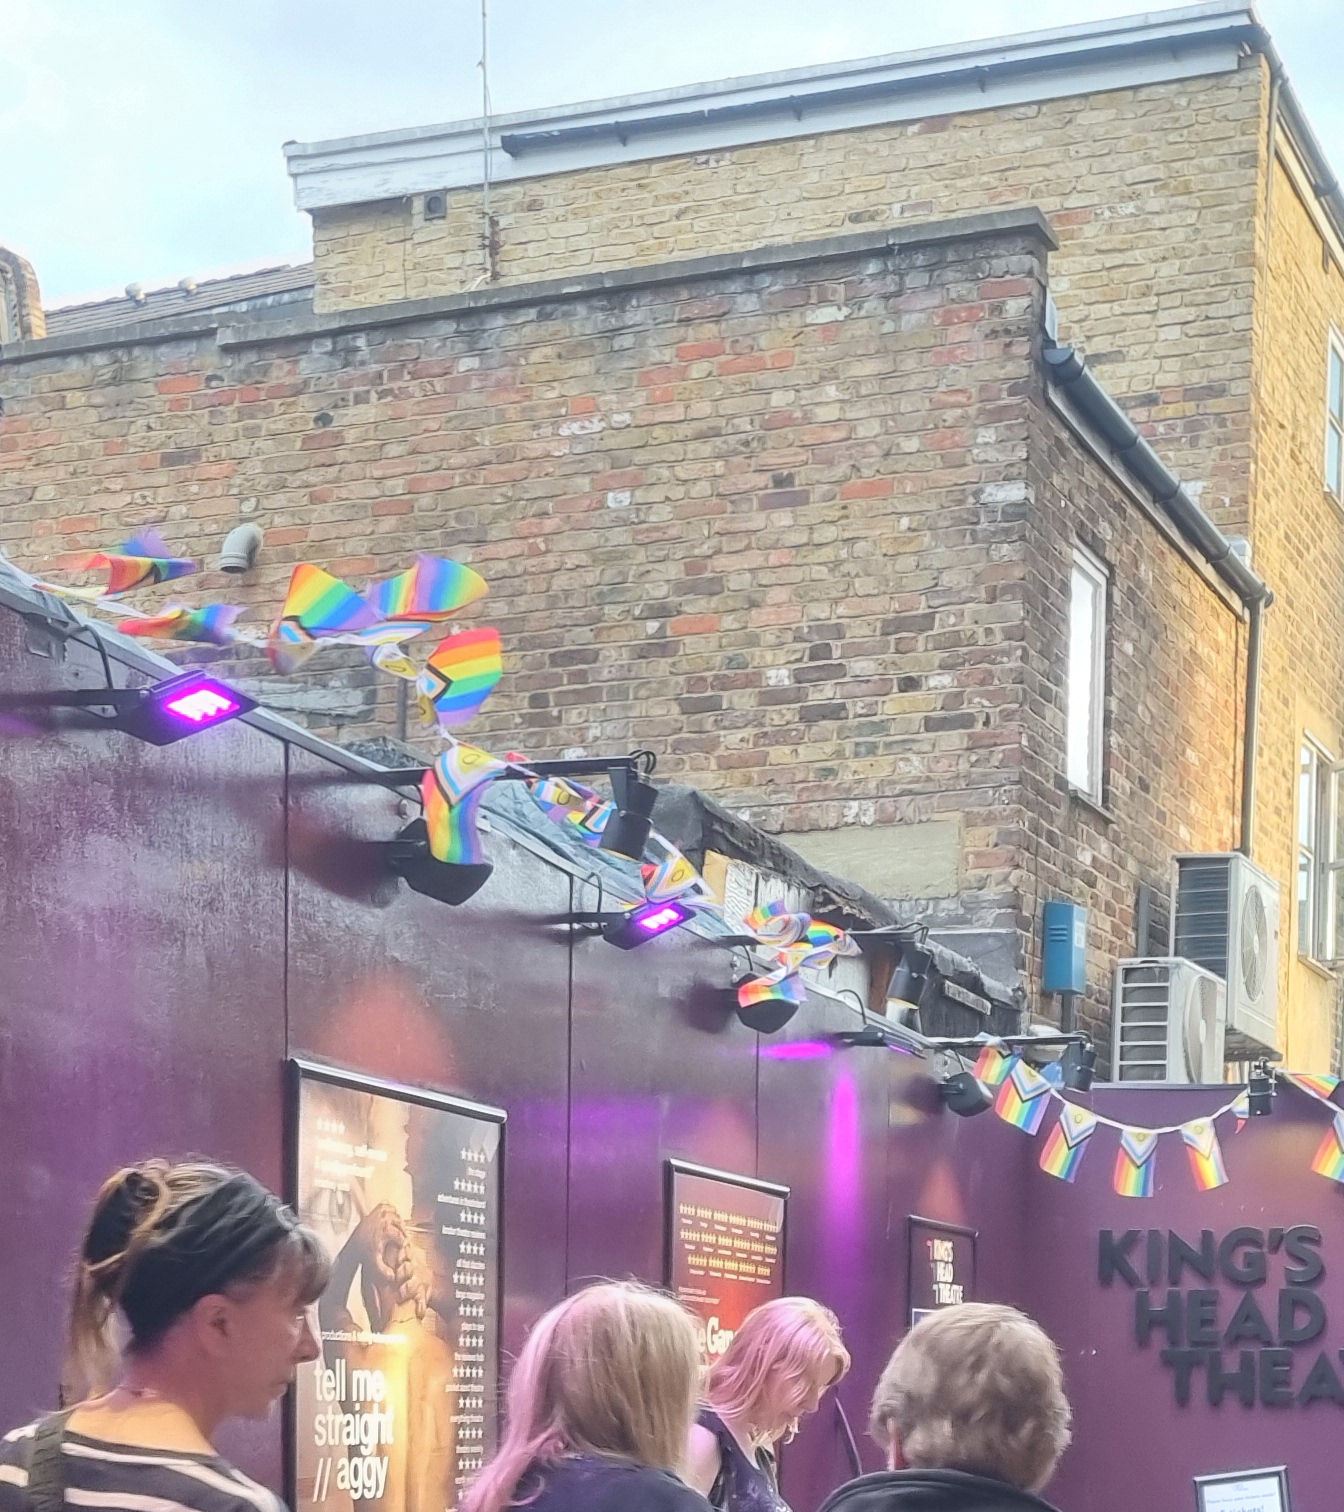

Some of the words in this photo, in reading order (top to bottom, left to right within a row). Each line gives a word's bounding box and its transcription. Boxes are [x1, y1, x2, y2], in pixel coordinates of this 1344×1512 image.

[1098, 1224, 1326, 1288] KING'S
[1134, 1287, 1328, 1348] HEAD
[314, 1358, 347, 1401] tell
[352, 1369, 386, 1402] me
[314, 1403, 394, 1456] straight
[337, 1456, 389, 1500] aggy
